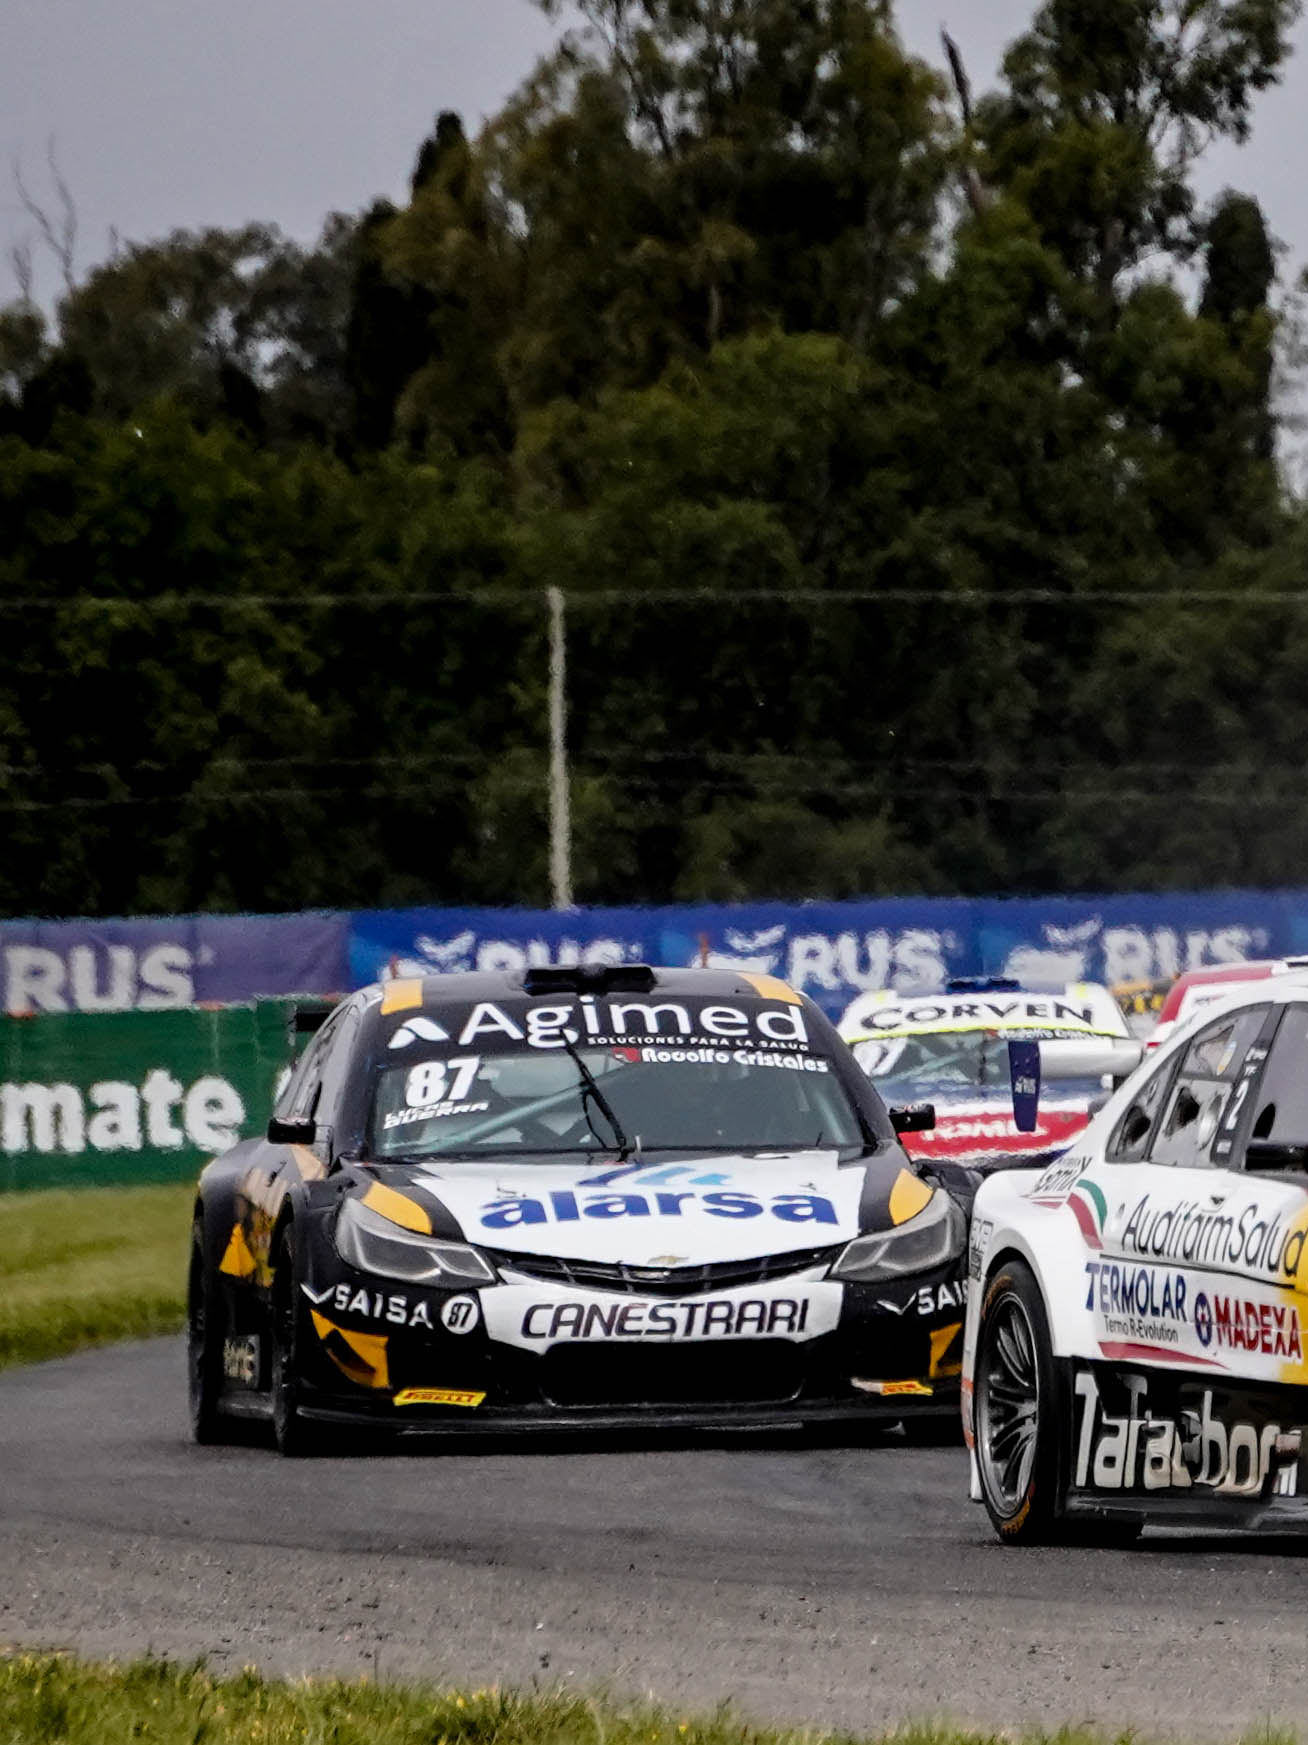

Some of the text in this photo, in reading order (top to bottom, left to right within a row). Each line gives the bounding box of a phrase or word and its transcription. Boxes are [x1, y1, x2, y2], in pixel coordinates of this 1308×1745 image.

[4, 943, 197, 1012] RUS
[790, 928, 947, 991] RUS
[458, 995, 809, 1047] Agimed
[860, 1001, 1094, 1031] CORVEN
[587, 1036, 809, 1052] SOLUCIONES PARA LA SALUD
[732, 1050, 829, 1073] Cristales
[405, 1054, 481, 1108] 87
[0, 1068, 246, 1154] mate
[481, 1189, 840, 1231] alarsa
[334, 1284, 435, 1330] SAISA
[917, 1280, 969, 1316] SAI
[1084, 1262, 1188, 1322] TERMOLAR
[520, 1298, 810, 1339] CANESTRARI
[1104, 1314, 1129, 1335] Termo
[1213, 1293, 1303, 1359] MADEXA
